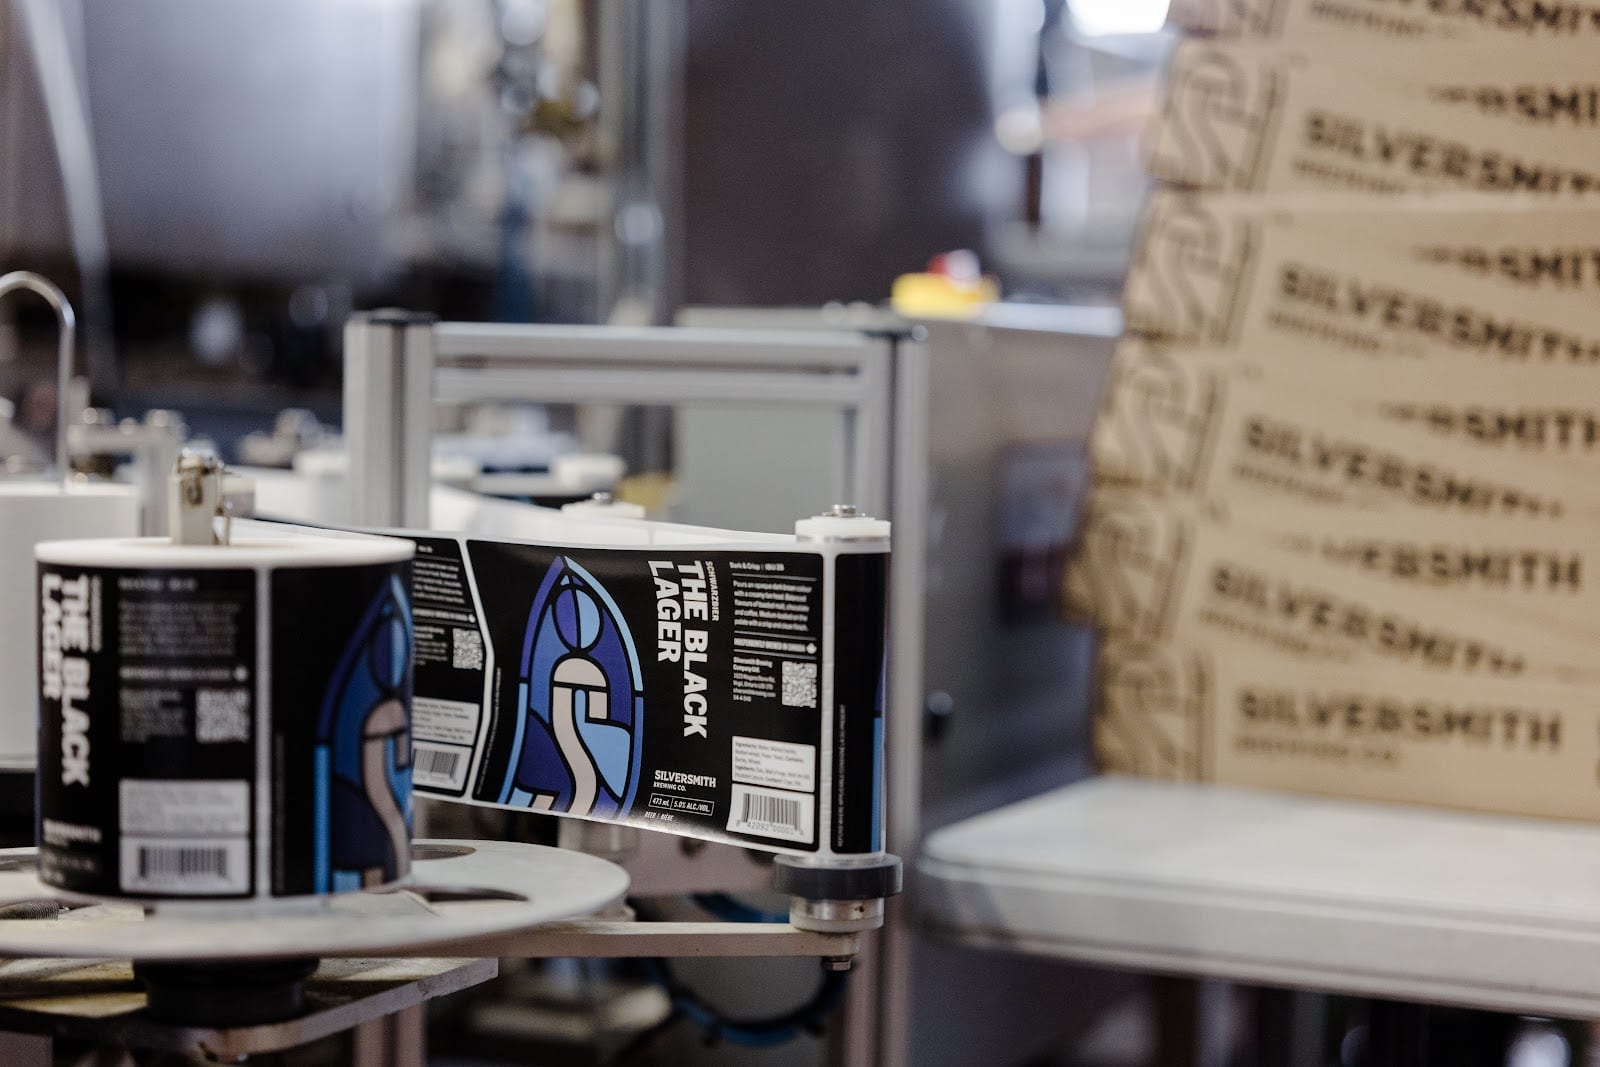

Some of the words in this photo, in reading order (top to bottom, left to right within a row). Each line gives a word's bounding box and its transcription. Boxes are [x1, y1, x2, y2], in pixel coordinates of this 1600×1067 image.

[43, 572, 63, 700] LAGER
[647, 560, 682, 663] LAGER
[677, 560, 709, 621] THE
[61, 657, 90, 787] BLACK
[683, 629, 709, 739] BLACK
[653, 781, 677, 791] BREWING
[654, 769, 717, 788] SILVERSMITH
